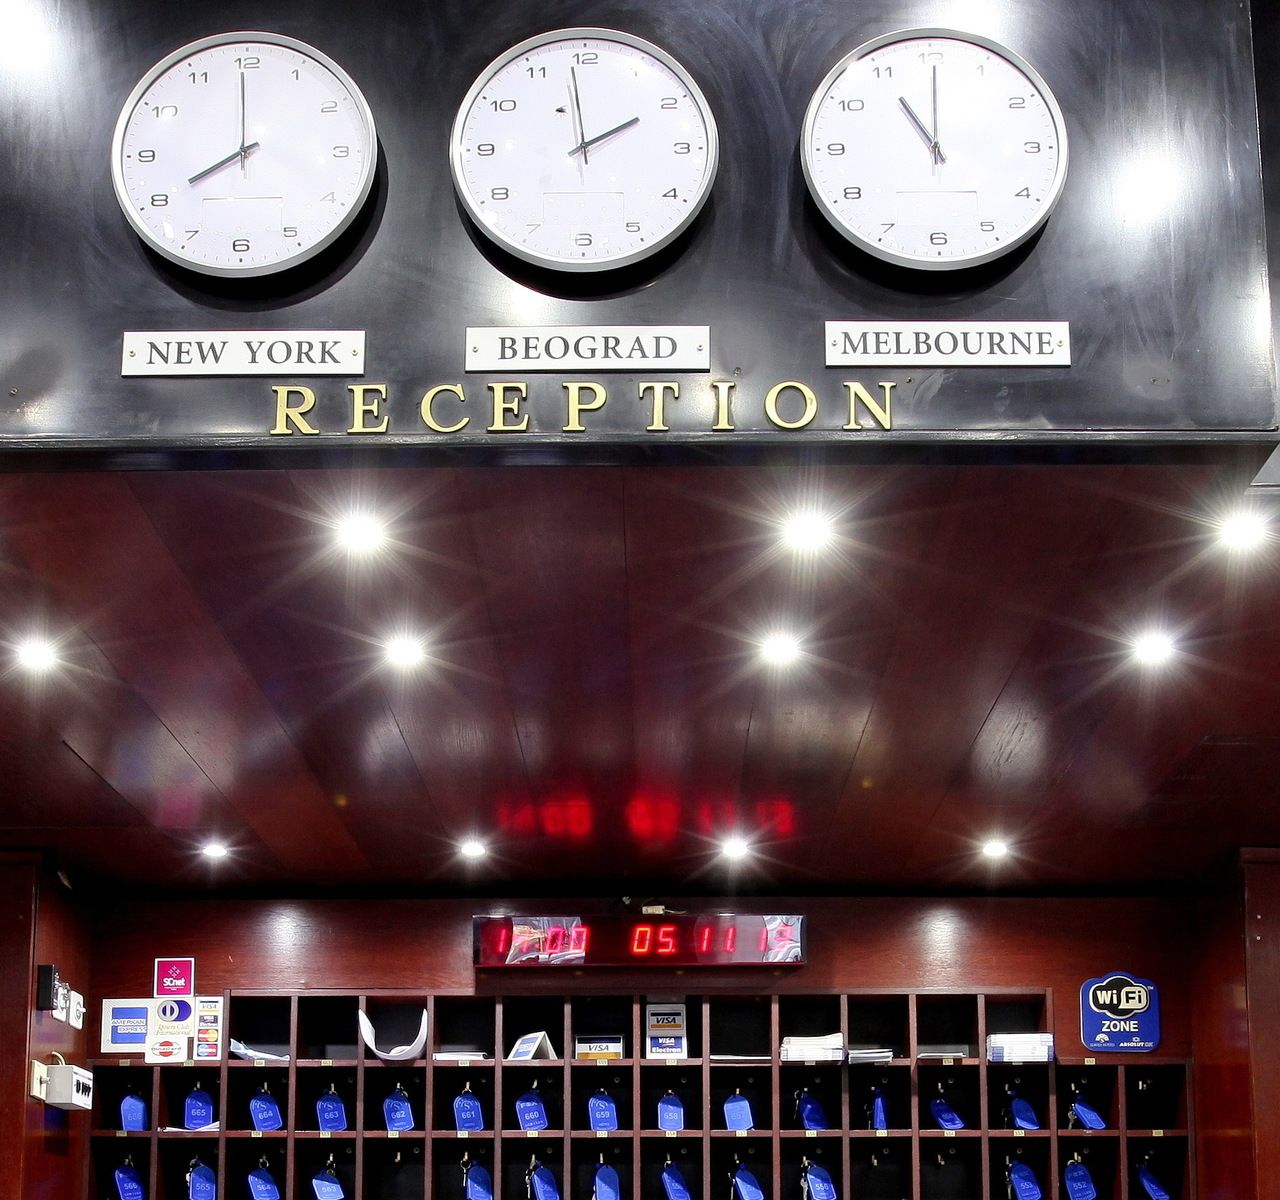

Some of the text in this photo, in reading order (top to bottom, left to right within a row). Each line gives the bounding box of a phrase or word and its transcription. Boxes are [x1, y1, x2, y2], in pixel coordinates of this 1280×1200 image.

[233, 56, 261, 70] 12
[571, 52, 599, 66] 12
[187, 71, 210, 84] 11
[290, 68, 300, 82] 1
[525, 66, 547, 80] 11
[872, 65, 893, 79] 11
[319, 100, 338, 114] 2
[489, 99, 518, 113] 10
[660, 97, 679, 110] 2
[837, 99, 865, 113] 10
[1008, 96, 1027, 110] 2
[151, 104, 179, 119] 10
[332, 145, 350, 159] 3
[476, 143, 496, 157] 9
[672, 141, 692, 155] 3
[826, 142, 846, 156] 9
[1023, 140, 1042, 154] 3
[137, 149, 156, 163] 9
[150, 193, 169, 207] 8
[319, 190, 337, 204] 4
[490, 187, 510, 201] 8
[661, 187, 679, 201] 4
[843, 186, 862, 201] 8
[1014, 186, 1032, 200] 4
[282, 226, 299, 238] 5
[525, 223, 542, 235] 7
[625, 221, 641, 234] 5
[879, 222, 896, 234] 7
[979, 220, 996, 233] 5
[184, 229, 200, 242] 7
[574, 232, 593, 247] 6
[929, 231, 949, 246] 6
[231, 238, 251, 253] 6
[497, 335, 678, 360] BEOGRAD
[840, 331, 1055, 356] MELBOURNE
[146, 340, 342, 365] NEW YORK
[269, 380, 898, 436] RECEPTION
[656, 1016, 677, 1025] VISA
[1101, 1020, 1139, 1032] ZONE
[588, 1044, 609, 1052] VISA
[191, 1109, 206, 1117] 665
[258, 1110, 273, 1120] 664
[324, 1111, 339, 1120] 663
[391, 1111, 405, 1119] 662
[461, 1111, 475, 1119] 661
[524, 1111, 539, 1120] 660
[595, 1111, 610, 1119] 659
[196, 1183, 210, 1191] 565
[1020, 1181, 1033, 1189] 553
[1072, 1182, 1087, 1191] 552
